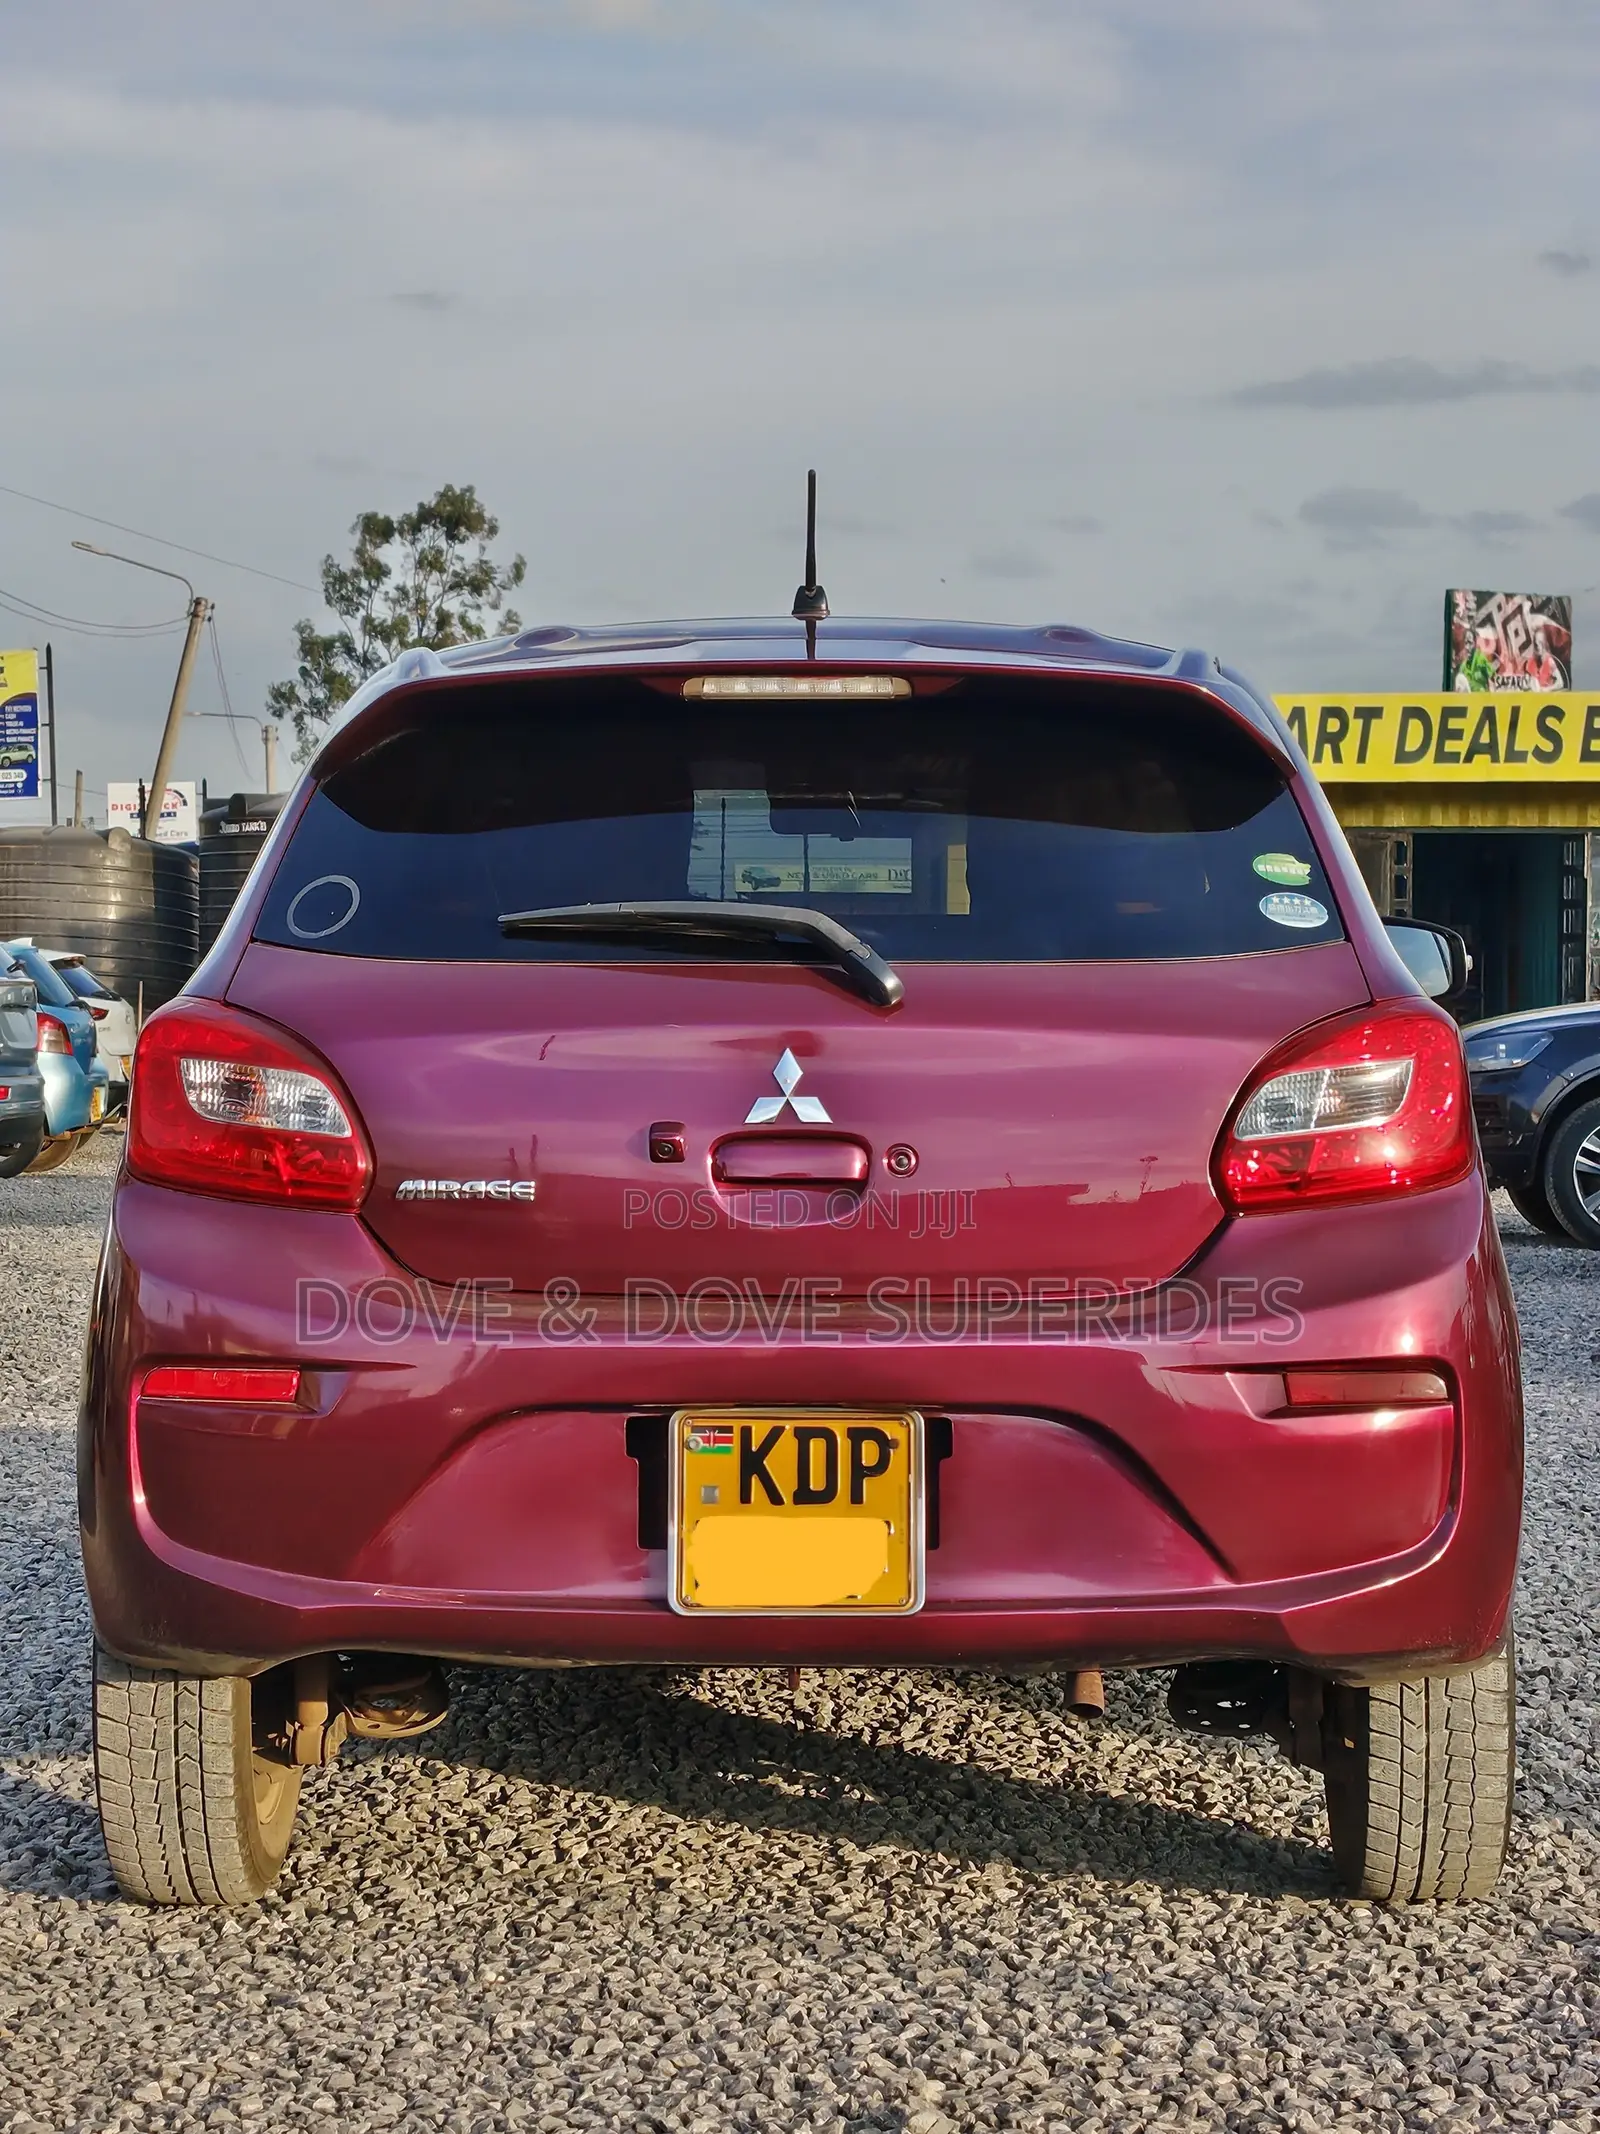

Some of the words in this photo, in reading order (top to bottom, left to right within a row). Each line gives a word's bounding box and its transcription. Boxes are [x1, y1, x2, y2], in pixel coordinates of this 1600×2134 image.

[1394, 705, 1566, 764] DEALS
[395, 1180, 536, 1201] MIRAGE
[739, 1425, 894, 1506] KDP
